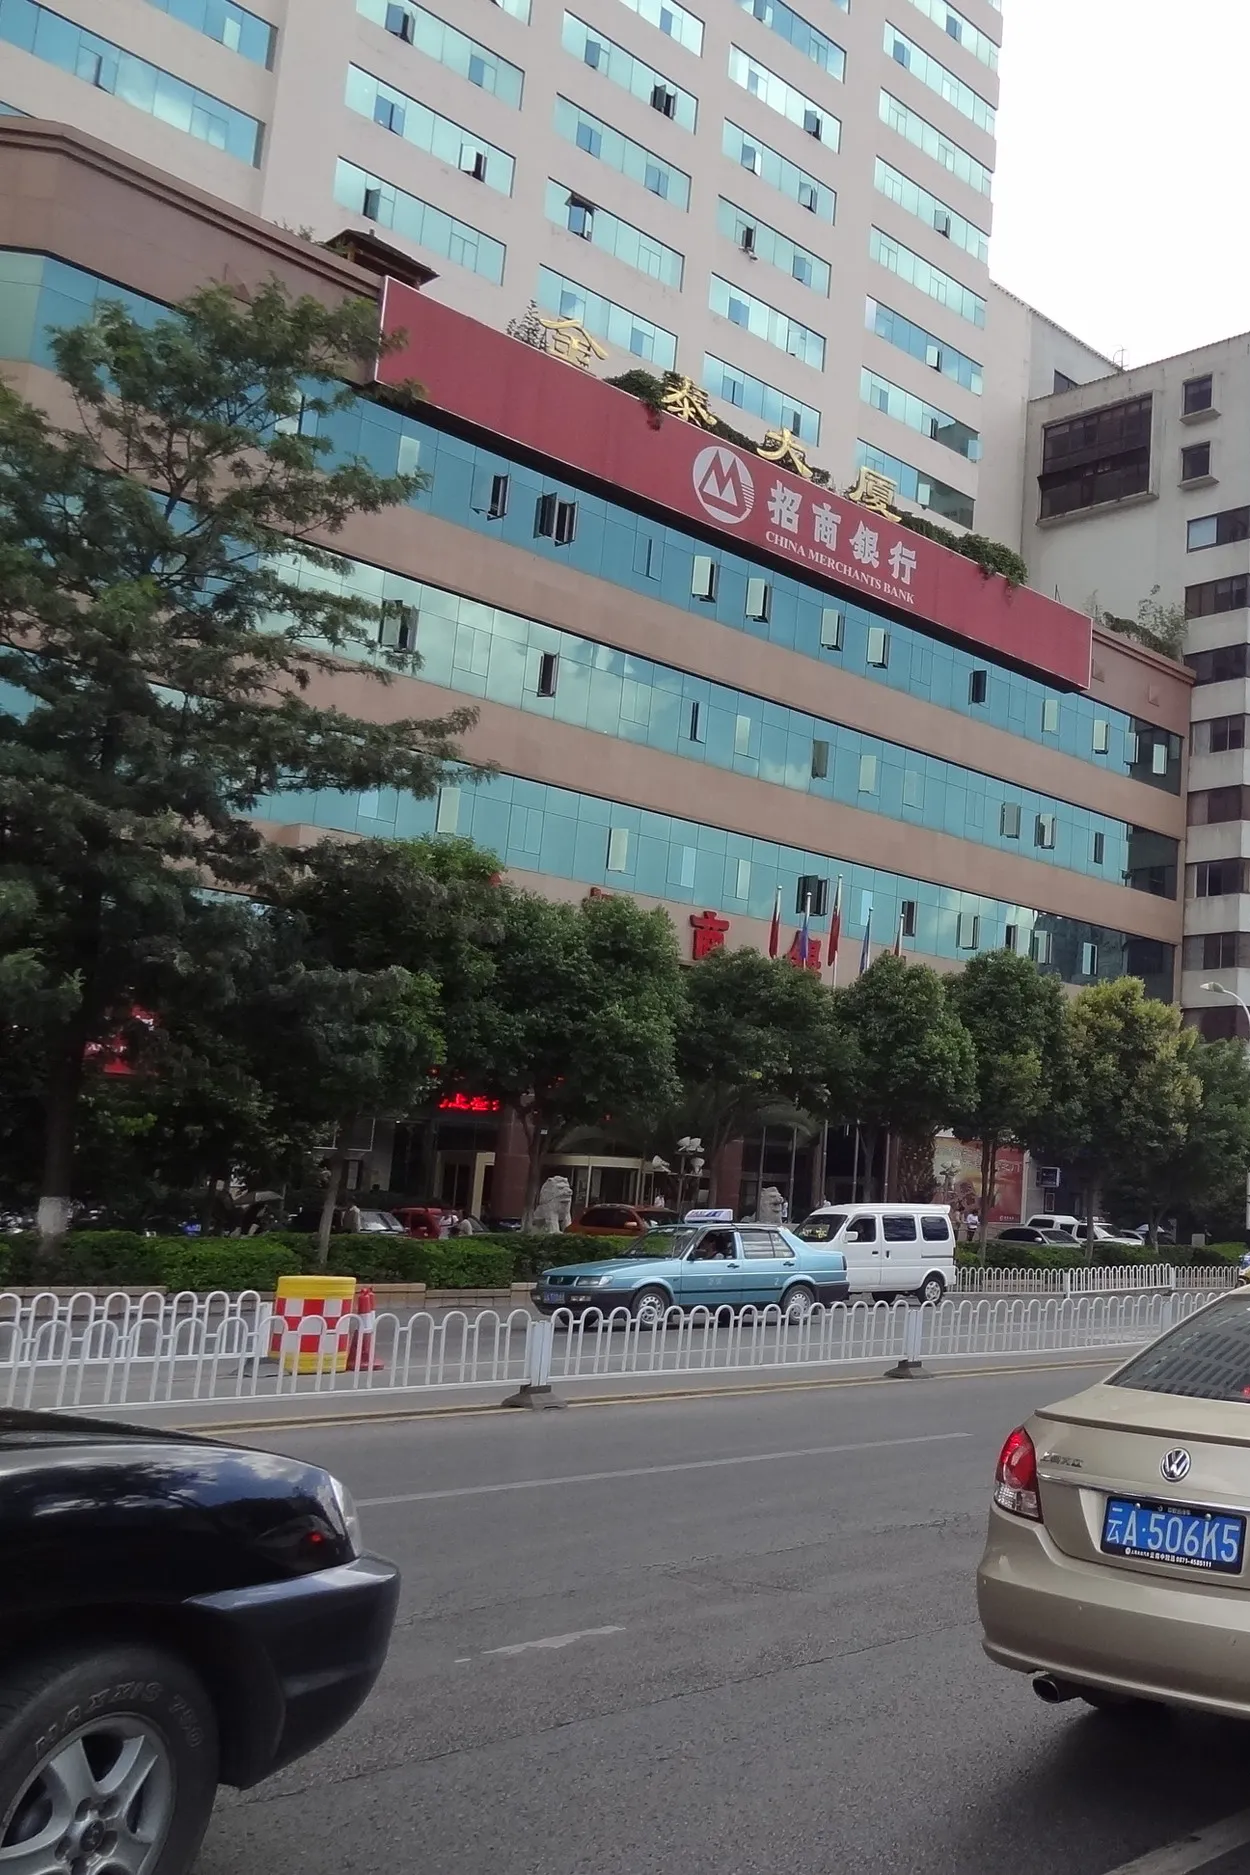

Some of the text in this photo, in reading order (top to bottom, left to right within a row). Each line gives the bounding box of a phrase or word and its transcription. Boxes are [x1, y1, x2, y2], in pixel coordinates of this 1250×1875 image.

[765, 530, 916, 604] CHINA MERCHANTS BANK
